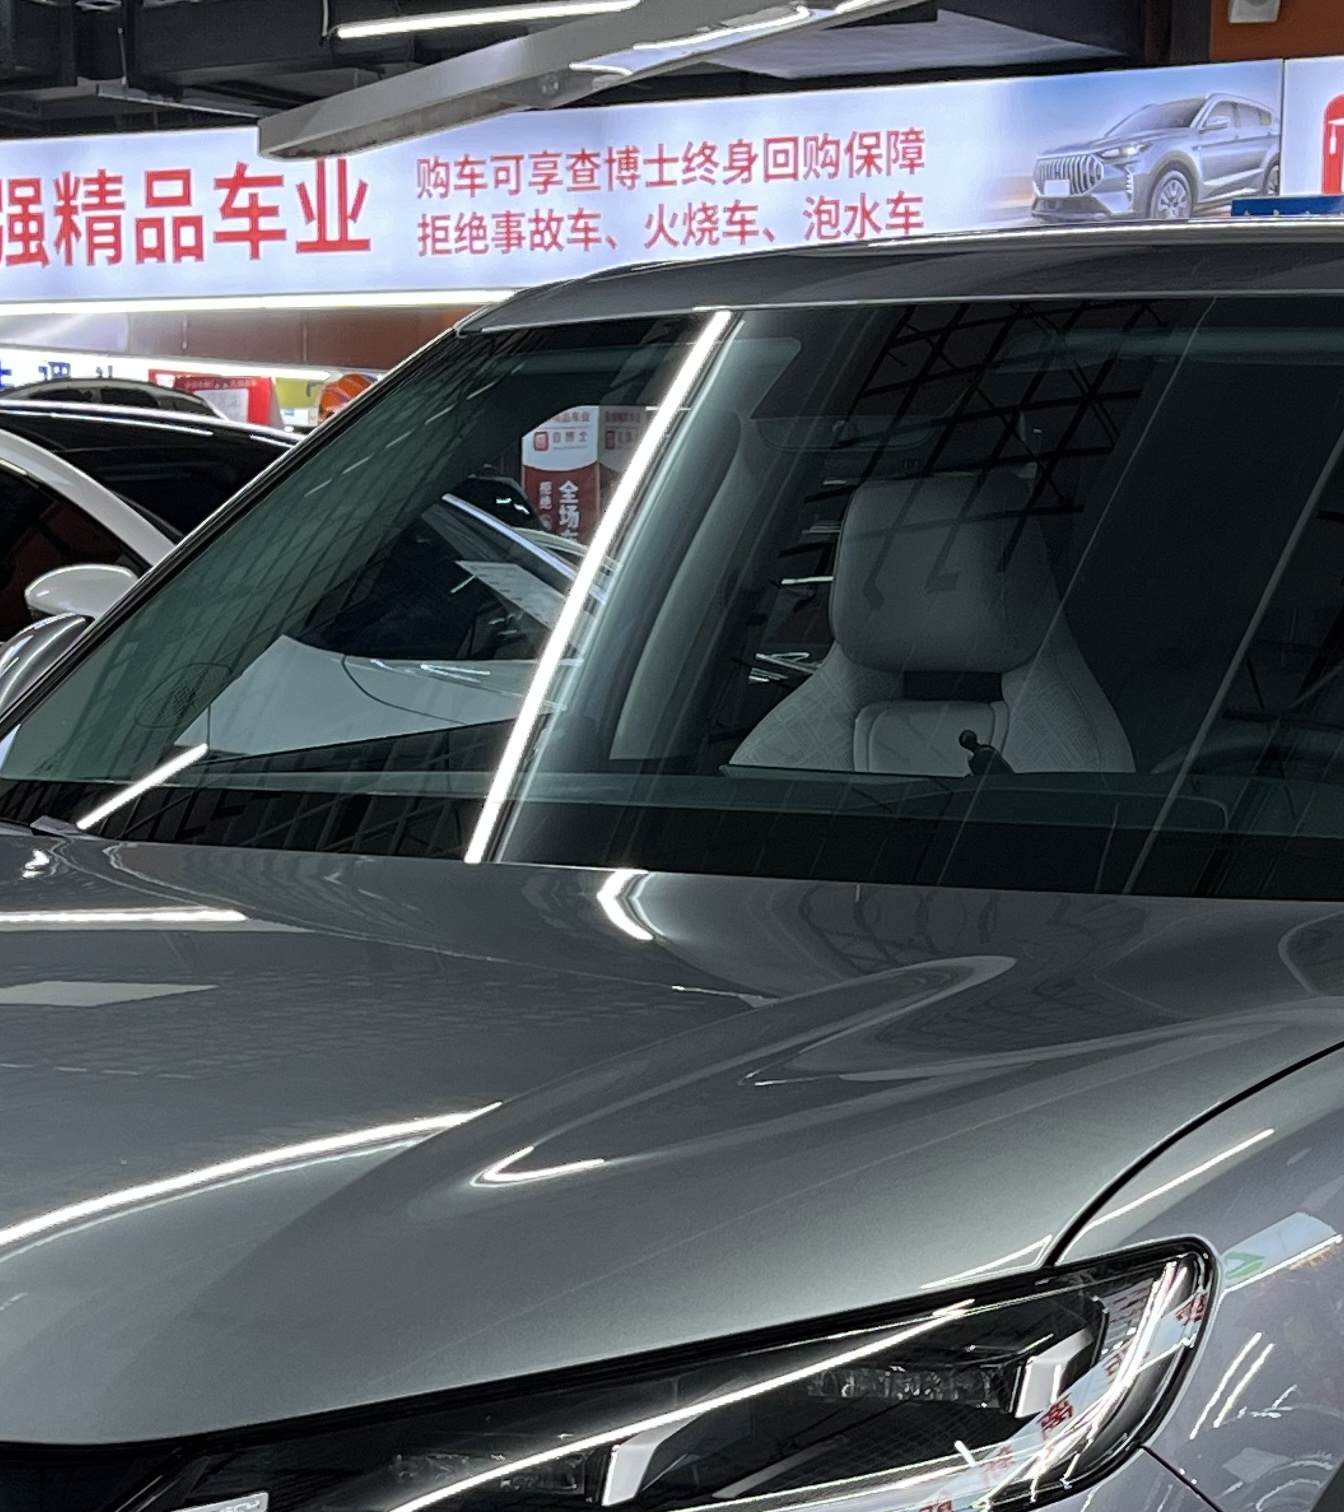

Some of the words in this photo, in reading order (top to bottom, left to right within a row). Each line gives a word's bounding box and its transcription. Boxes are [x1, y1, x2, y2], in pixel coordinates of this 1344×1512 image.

[415, 128, 926, 200] 购车可享查博士终身回购保障
